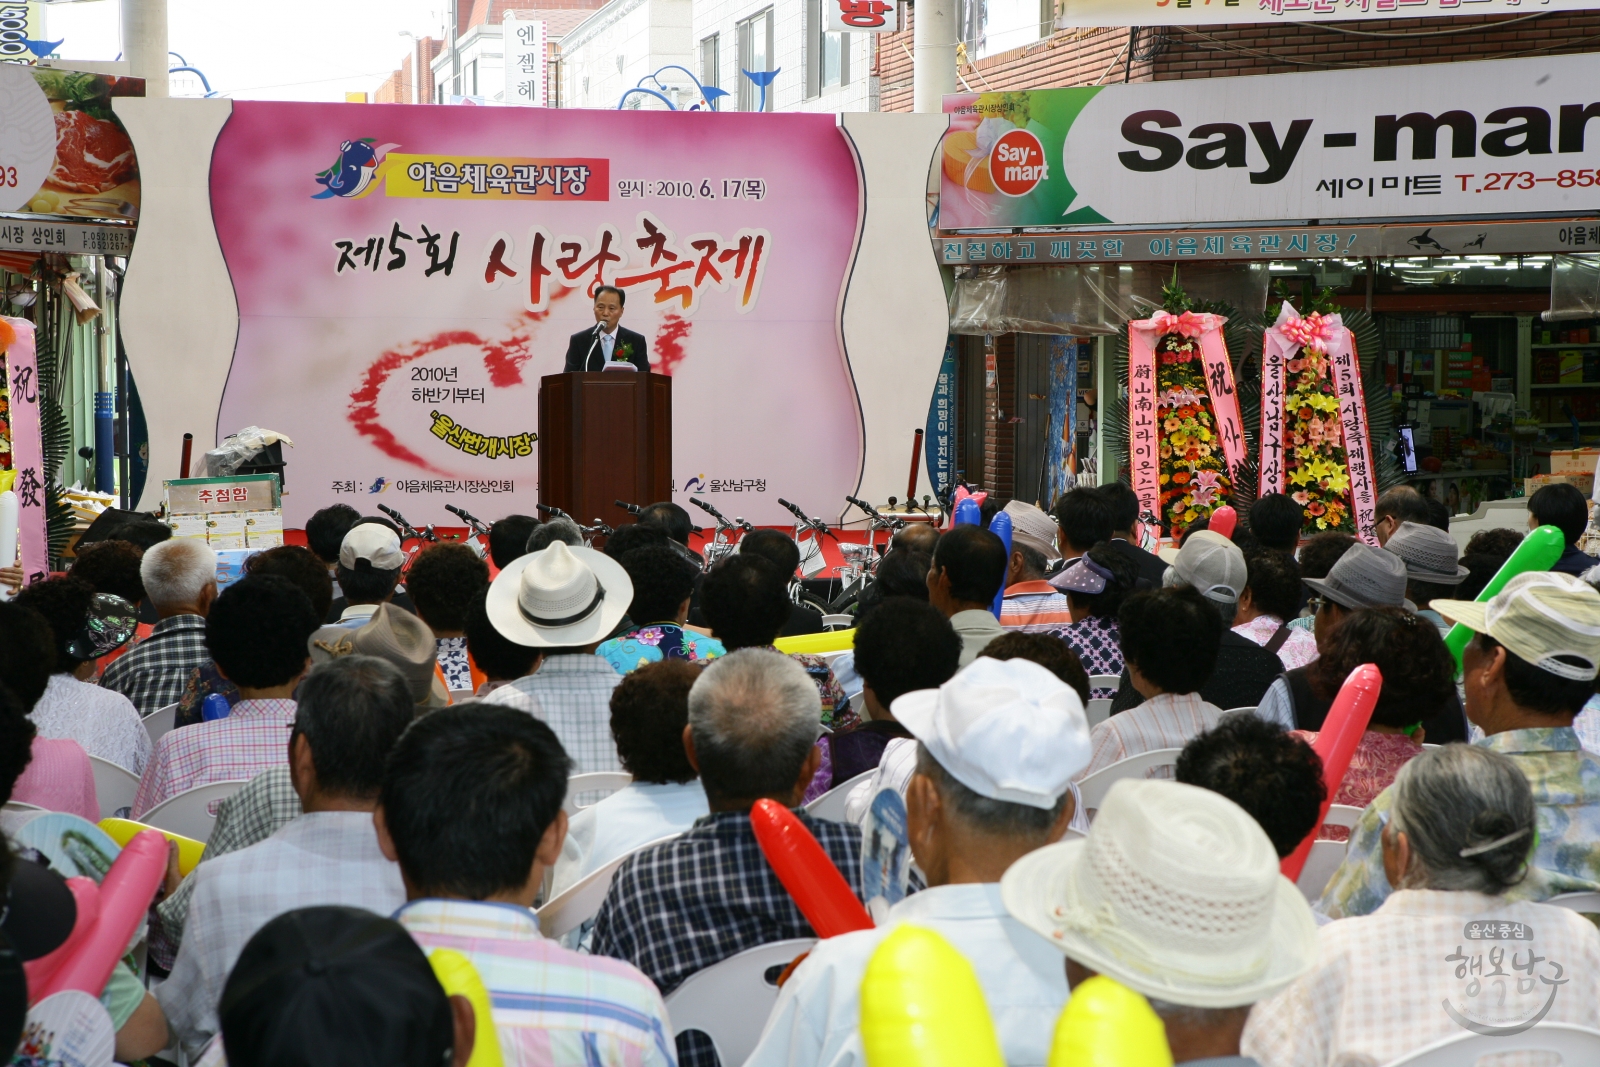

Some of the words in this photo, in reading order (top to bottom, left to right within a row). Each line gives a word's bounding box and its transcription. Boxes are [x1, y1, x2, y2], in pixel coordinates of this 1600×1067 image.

[516, 24, 536, 102] 엔젤헤
[407, 161, 590, 195] 야음체육관시장
[1004, 160, 1049, 181] mart
[618, 180, 644, 198] 일시
[656, 181, 695, 199] 2010.
[722, 179, 766, 200] 17(목)
[1315, 174, 1442, 199] 세이마트
[32, 227, 66, 246] 상인회
[943, 240, 1036, 261] 친절하고
[1050, 239, 1125, 260] 깨끗한
[1149, 233, 1357, 257] 야음체육관시장!
[335, 221, 460, 278] 제5회
[485, 217, 765, 310] 사랑축제
[411, 366, 458, 382] 2010년
[411, 387, 485, 404] 하반기부터
[198, 487, 248, 504] 추첨함
[331, 480, 356, 494] 주최
[396, 479, 514, 494] 야음체육관시장상인회
[709, 478, 766, 493] 울산남구청
